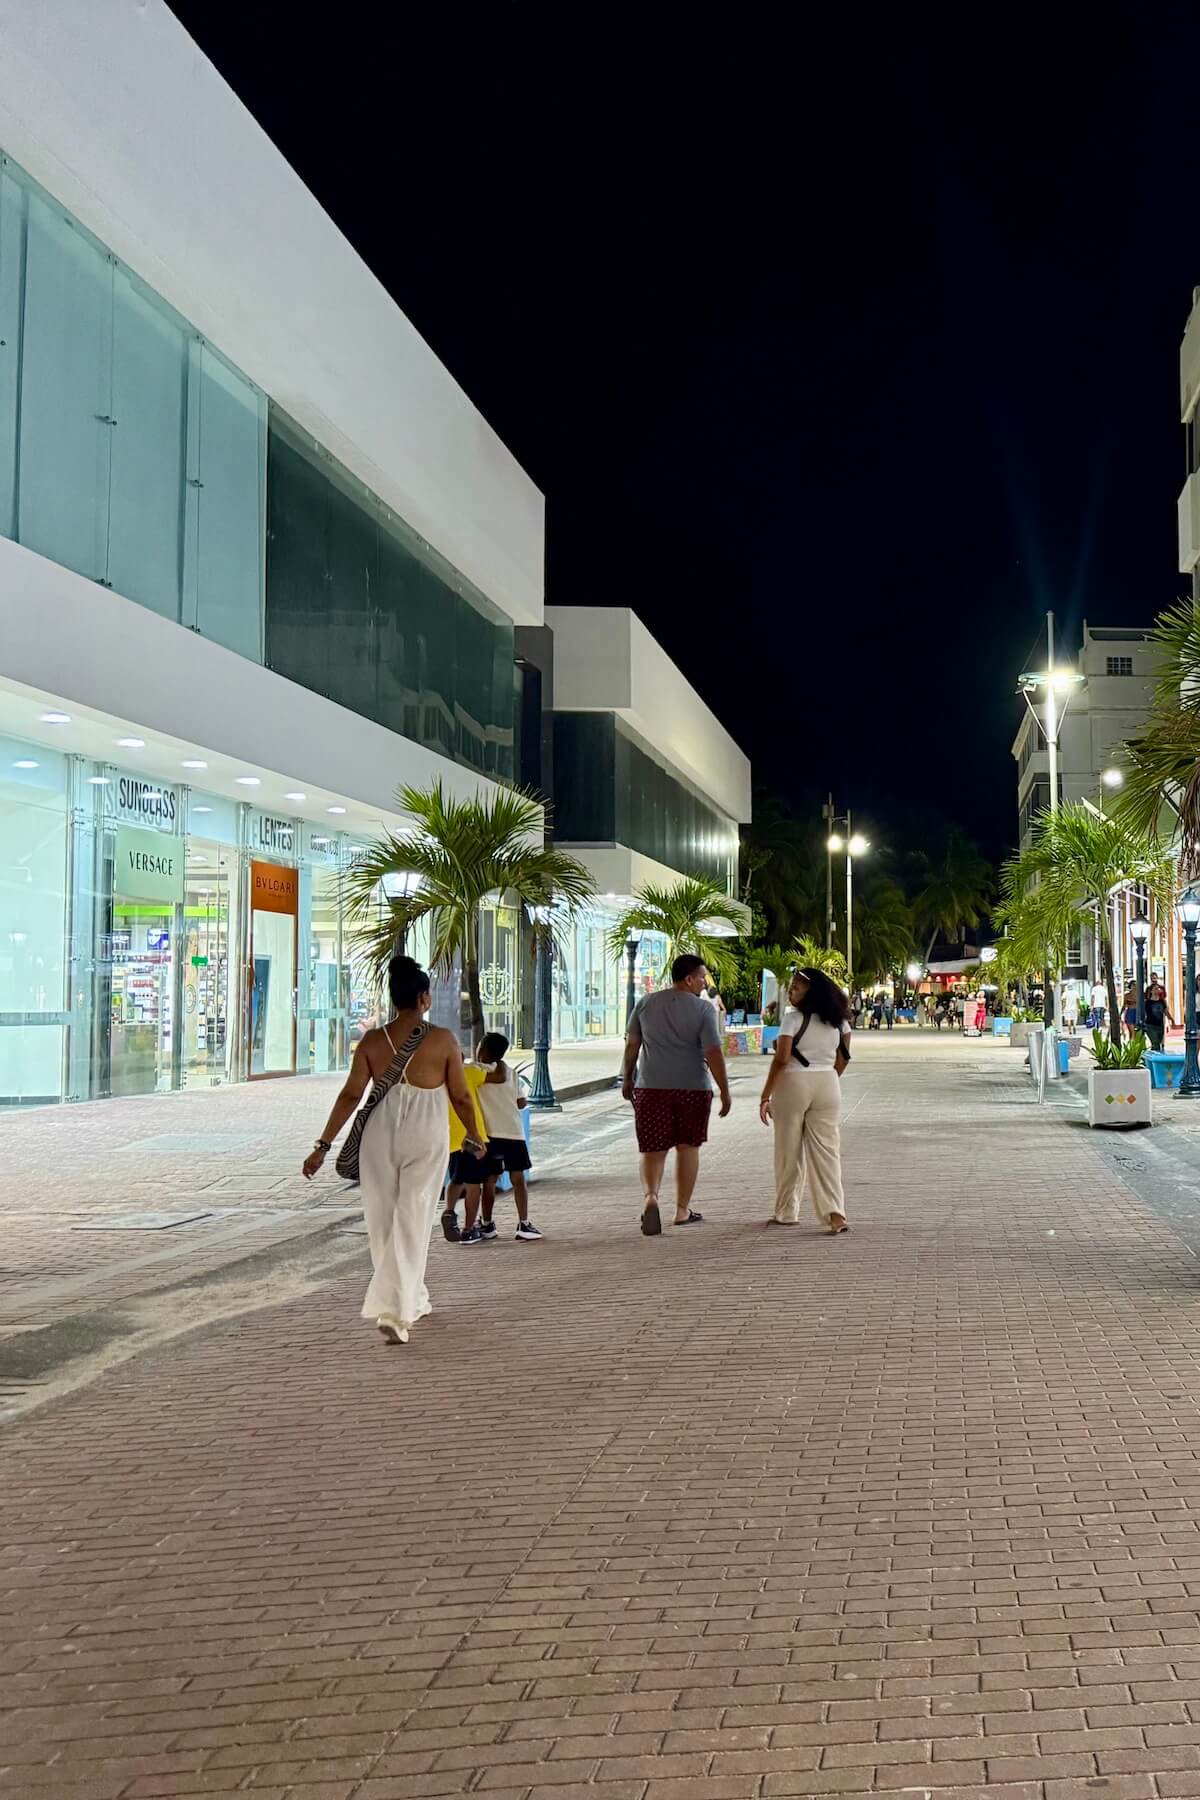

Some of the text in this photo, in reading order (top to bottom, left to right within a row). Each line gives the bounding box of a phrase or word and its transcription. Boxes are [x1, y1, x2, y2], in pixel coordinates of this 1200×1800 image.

[119, 778, 175, 820] SUNGLASS
[259, 815, 293, 851] LENTES
[129, 850, 174, 876] VERSACE
[256, 876, 295, 894] BVLGARI
